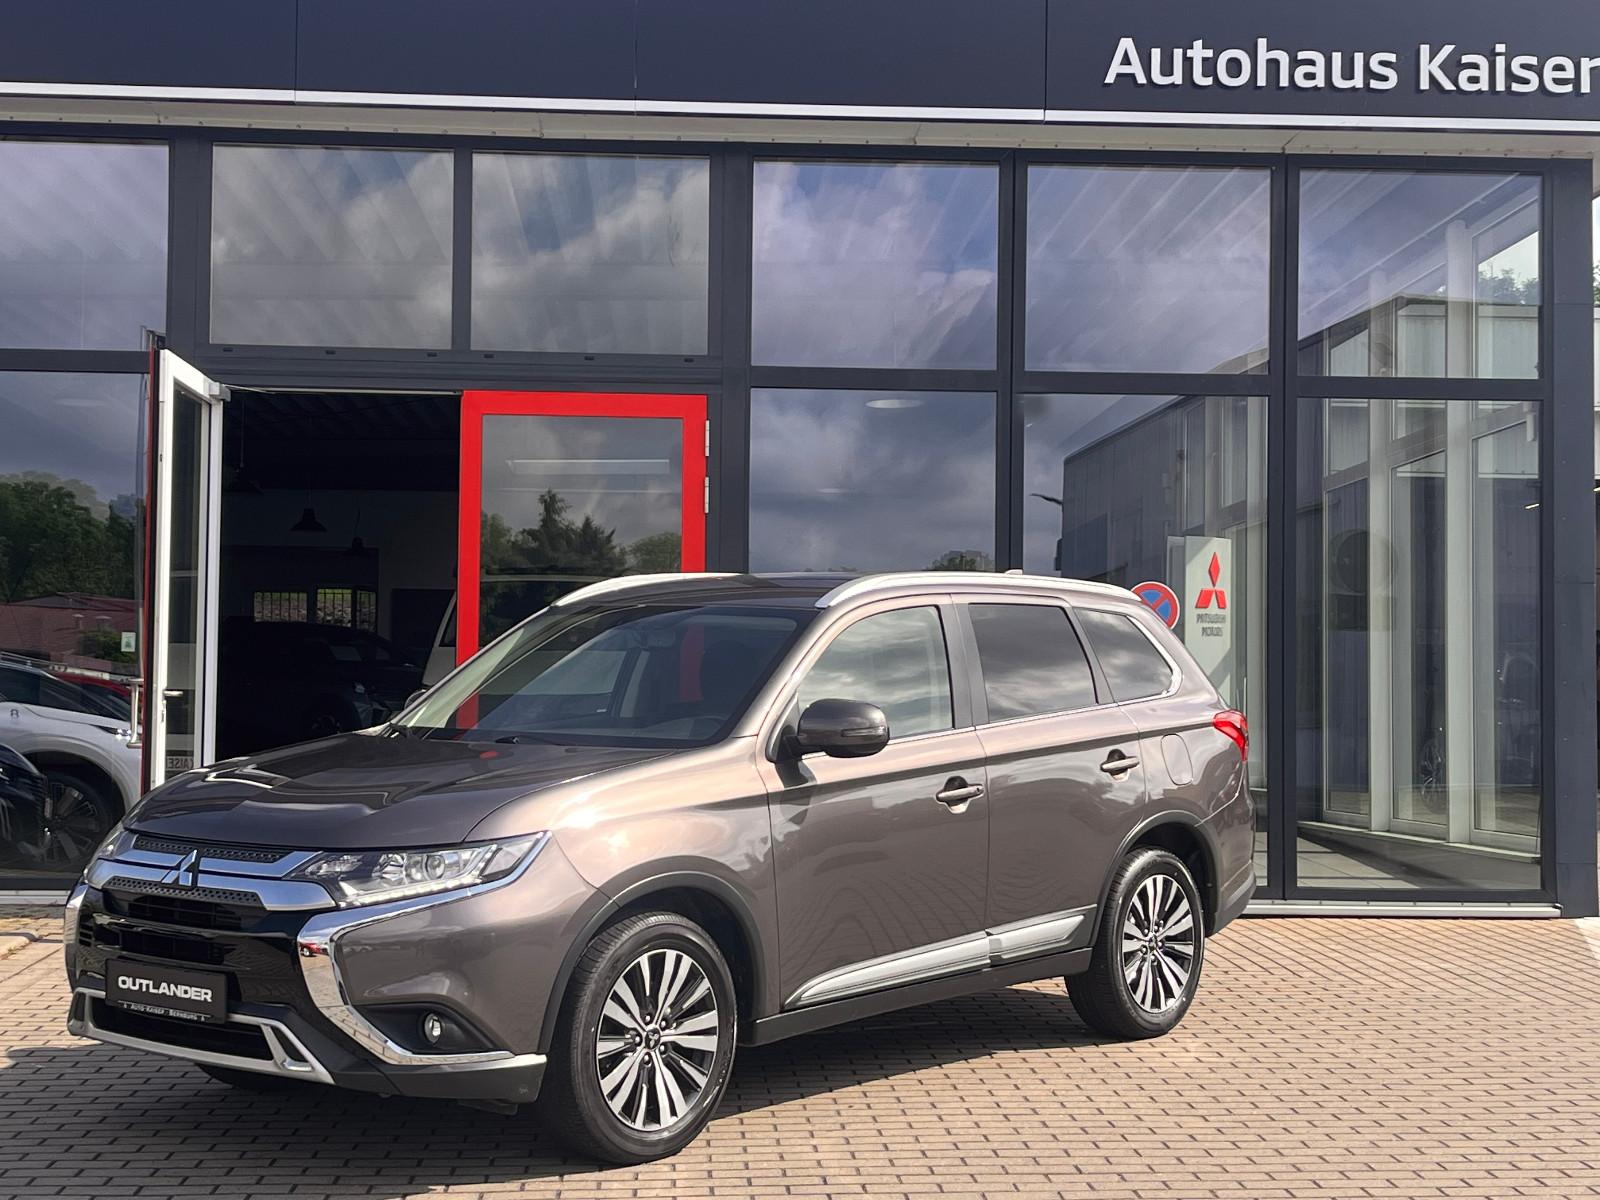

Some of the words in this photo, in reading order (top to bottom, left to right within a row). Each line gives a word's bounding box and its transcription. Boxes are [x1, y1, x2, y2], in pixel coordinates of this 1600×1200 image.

[1104, 37, 1398, 89] Autohaus
[1419, 44, 1600, 93] Kaiser
[118, 976, 212, 1002] OUTLANDER
